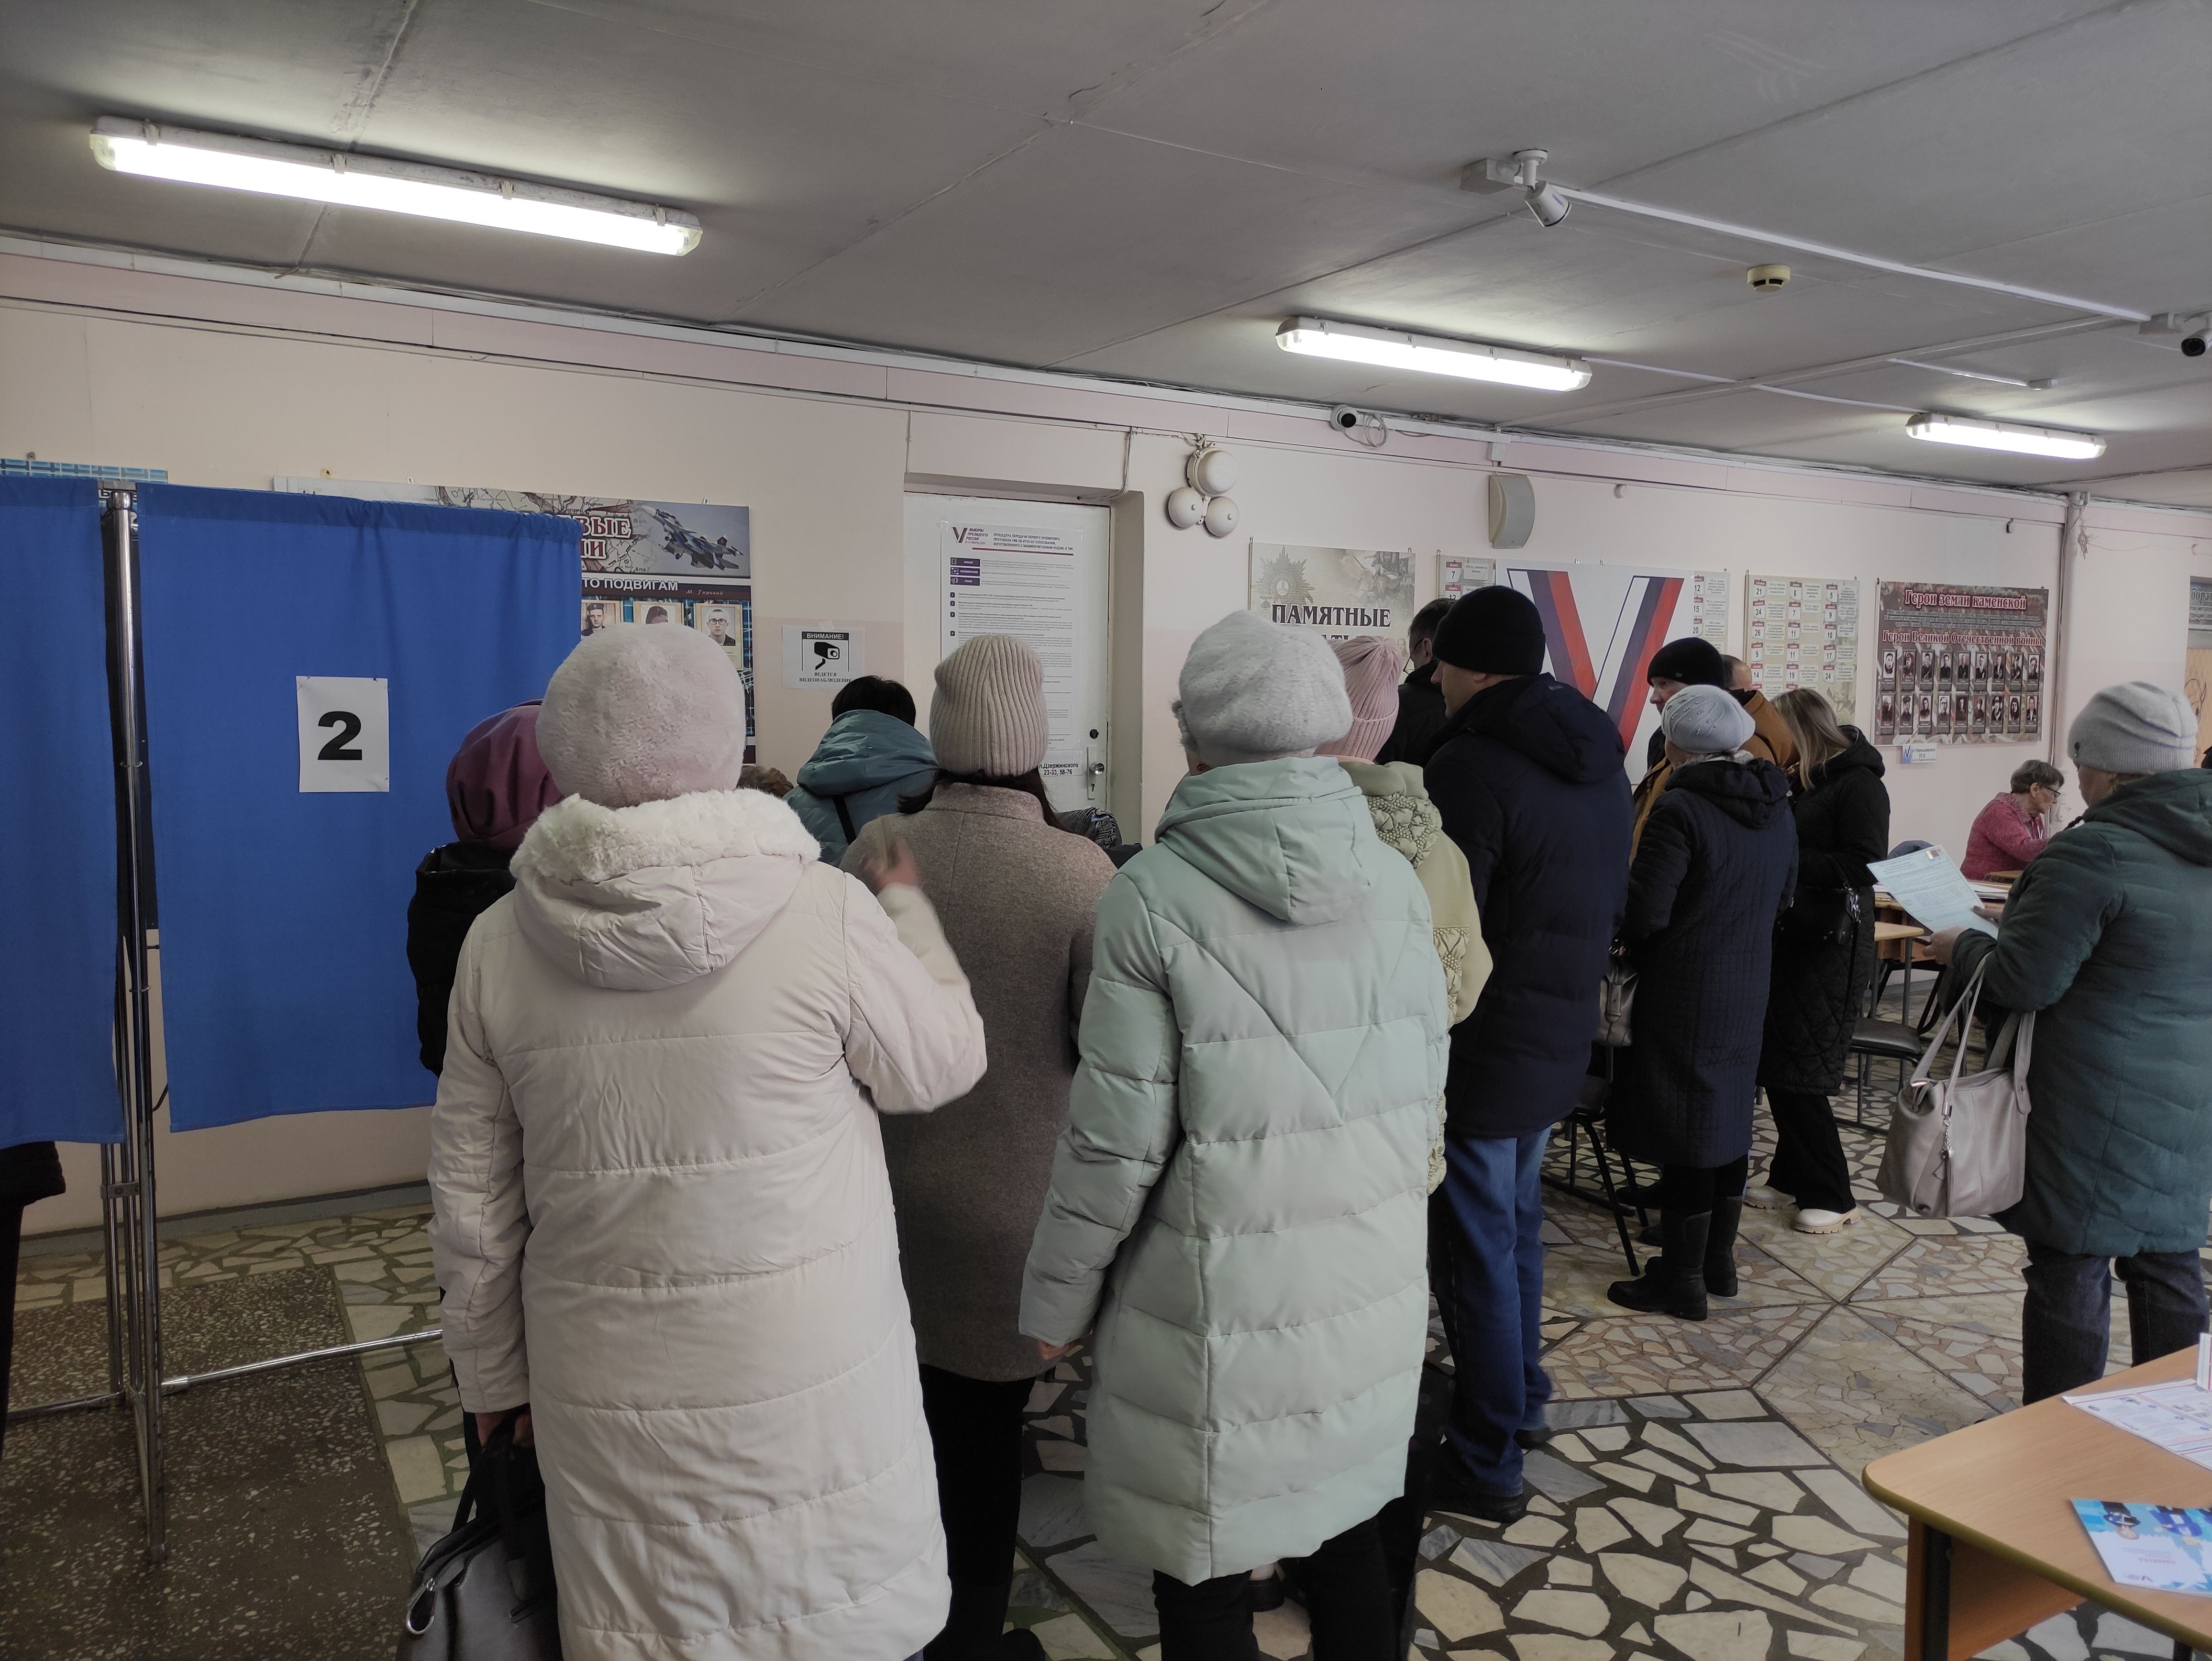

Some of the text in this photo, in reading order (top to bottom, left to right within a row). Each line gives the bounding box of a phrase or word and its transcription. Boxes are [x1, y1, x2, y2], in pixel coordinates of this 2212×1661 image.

[582, 577, 678, 591] ТО ПОДВИГАМ
[1905, 590, 2027, 609] Герои земли каменской
[1272, 604, 1391, 628] ПАМЯТНЫЕ
[1883, 630, 2043, 646] Герои Великой Отечественной войны
[318, 711, 362, 760] 2
